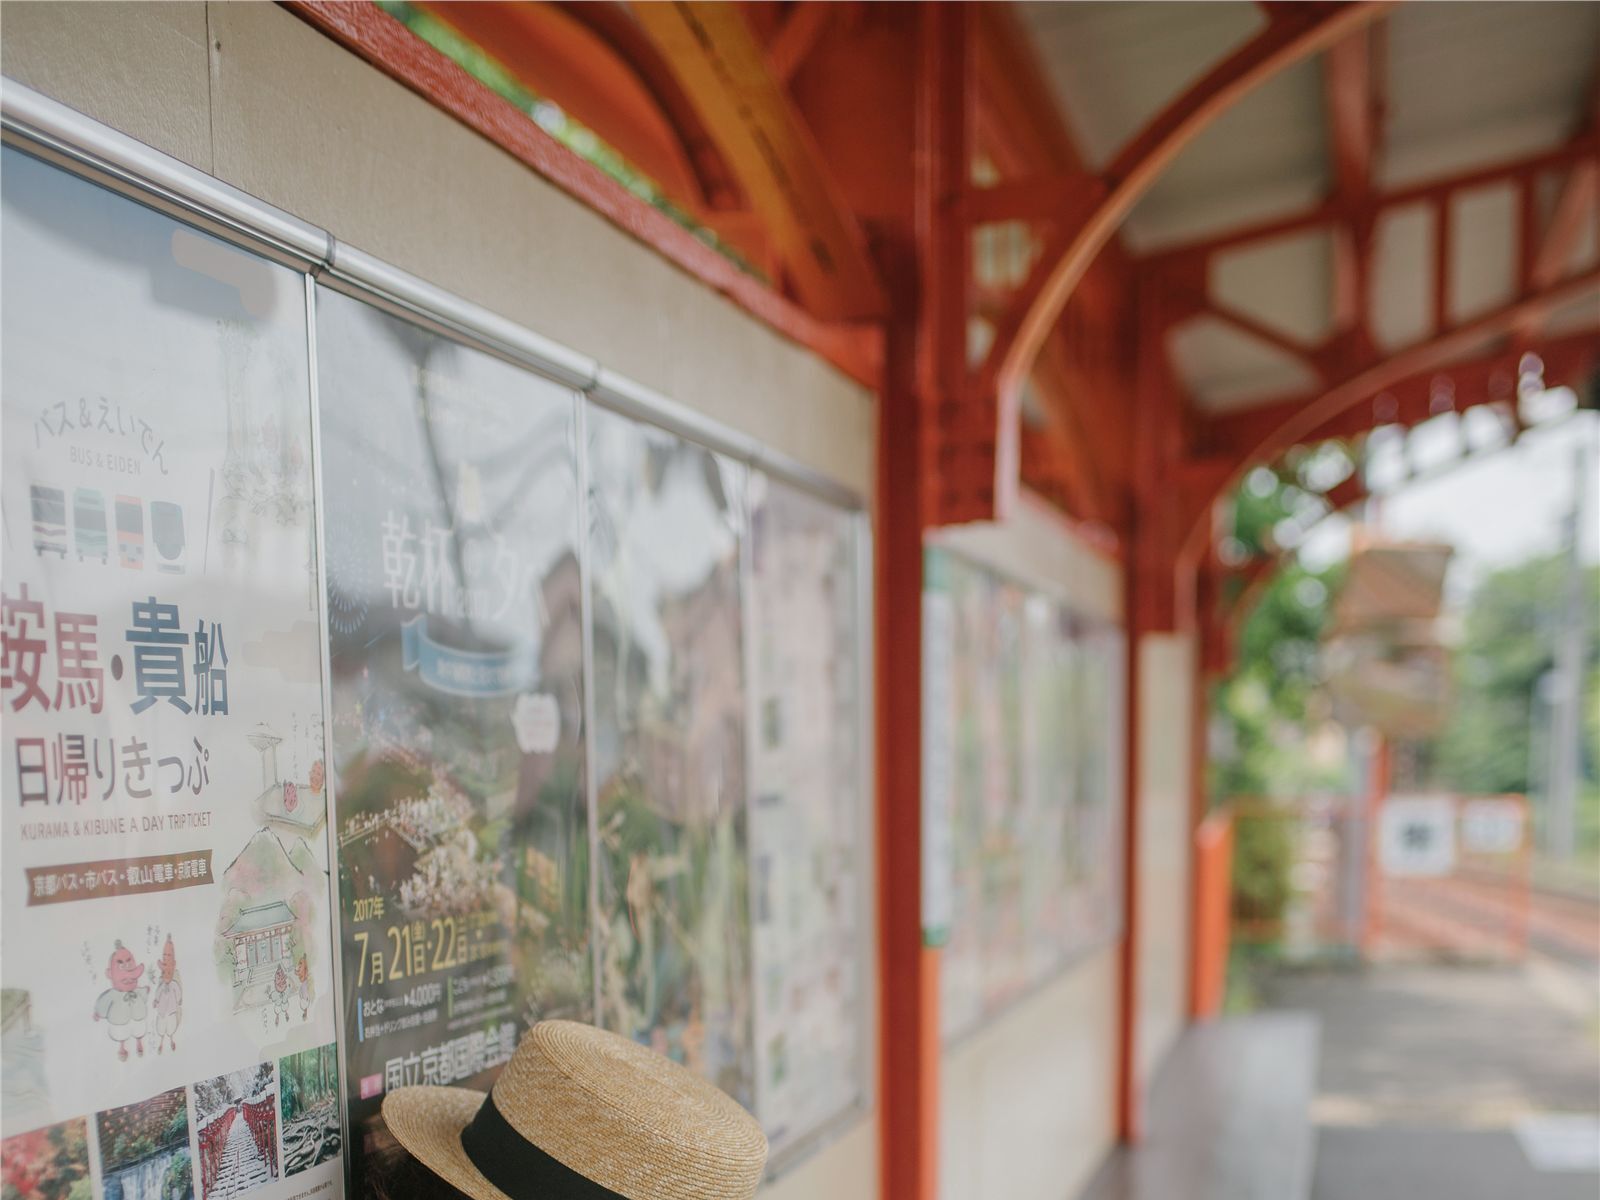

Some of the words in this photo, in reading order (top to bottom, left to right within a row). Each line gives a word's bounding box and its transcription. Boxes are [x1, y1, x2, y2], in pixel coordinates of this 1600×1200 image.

[69, 445, 92, 466] BUS
[95, 452, 104, 468] &
[106, 454, 141, 475] EIDEN
[21, 823, 69, 840] KURAMA
[73, 824, 80, 835] &
[83, 817, 125, 835] KIBUNE
[130, 818, 139, 833] A
[143, 815, 164, 832] DAY
[168, 814, 185, 830] TRIP
[187, 811, 212, 828] TICKET
[353, 896, 384, 922] 2017年
